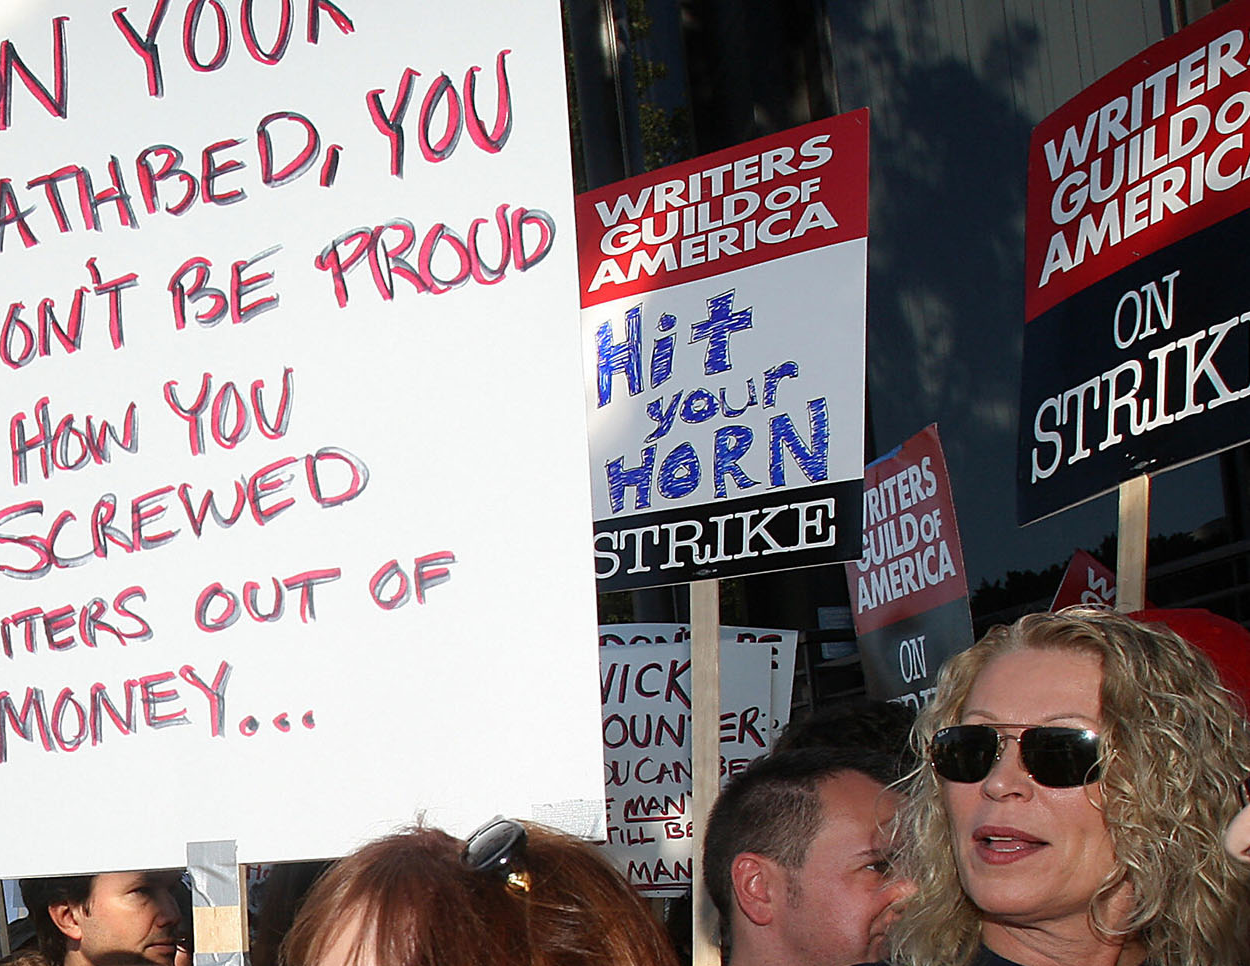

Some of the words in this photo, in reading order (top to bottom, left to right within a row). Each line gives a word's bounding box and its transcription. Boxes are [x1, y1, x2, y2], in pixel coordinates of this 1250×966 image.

[366, 49, 513, 181] YOU
[1043, 29, 1250, 182] WRITER
[595, 134, 833, 228] WRITERS
[1051, 103, 1213, 226] GUILD
[1214, 90, 1250, 135] O
[587, 201, 839, 293] AMERICA
[600, 191, 761, 257] GUILD
[764, 177, 821, 211] OF
[1038, 133, 1250, 289] AMERIC
[166, 245, 284, 331] BE
[314, 205, 557, 309] PROUD
[1112, 270, 1181, 350] ON
[595, 288, 754, 409] Hit
[8, 396, 141, 487] HOW
[163, 367, 295, 457] YOU
[643, 360, 800, 443] your
[604, 396, 830, 515] HORN
[593, 497, 836, 580] STRIKE
[919, 508, 942, 544] OF
[194, 567, 342, 634] OUT
[368, 550, 457, 611] OF
[857, 540, 957, 615] AMERICA
[899, 635, 927, 684] ON
